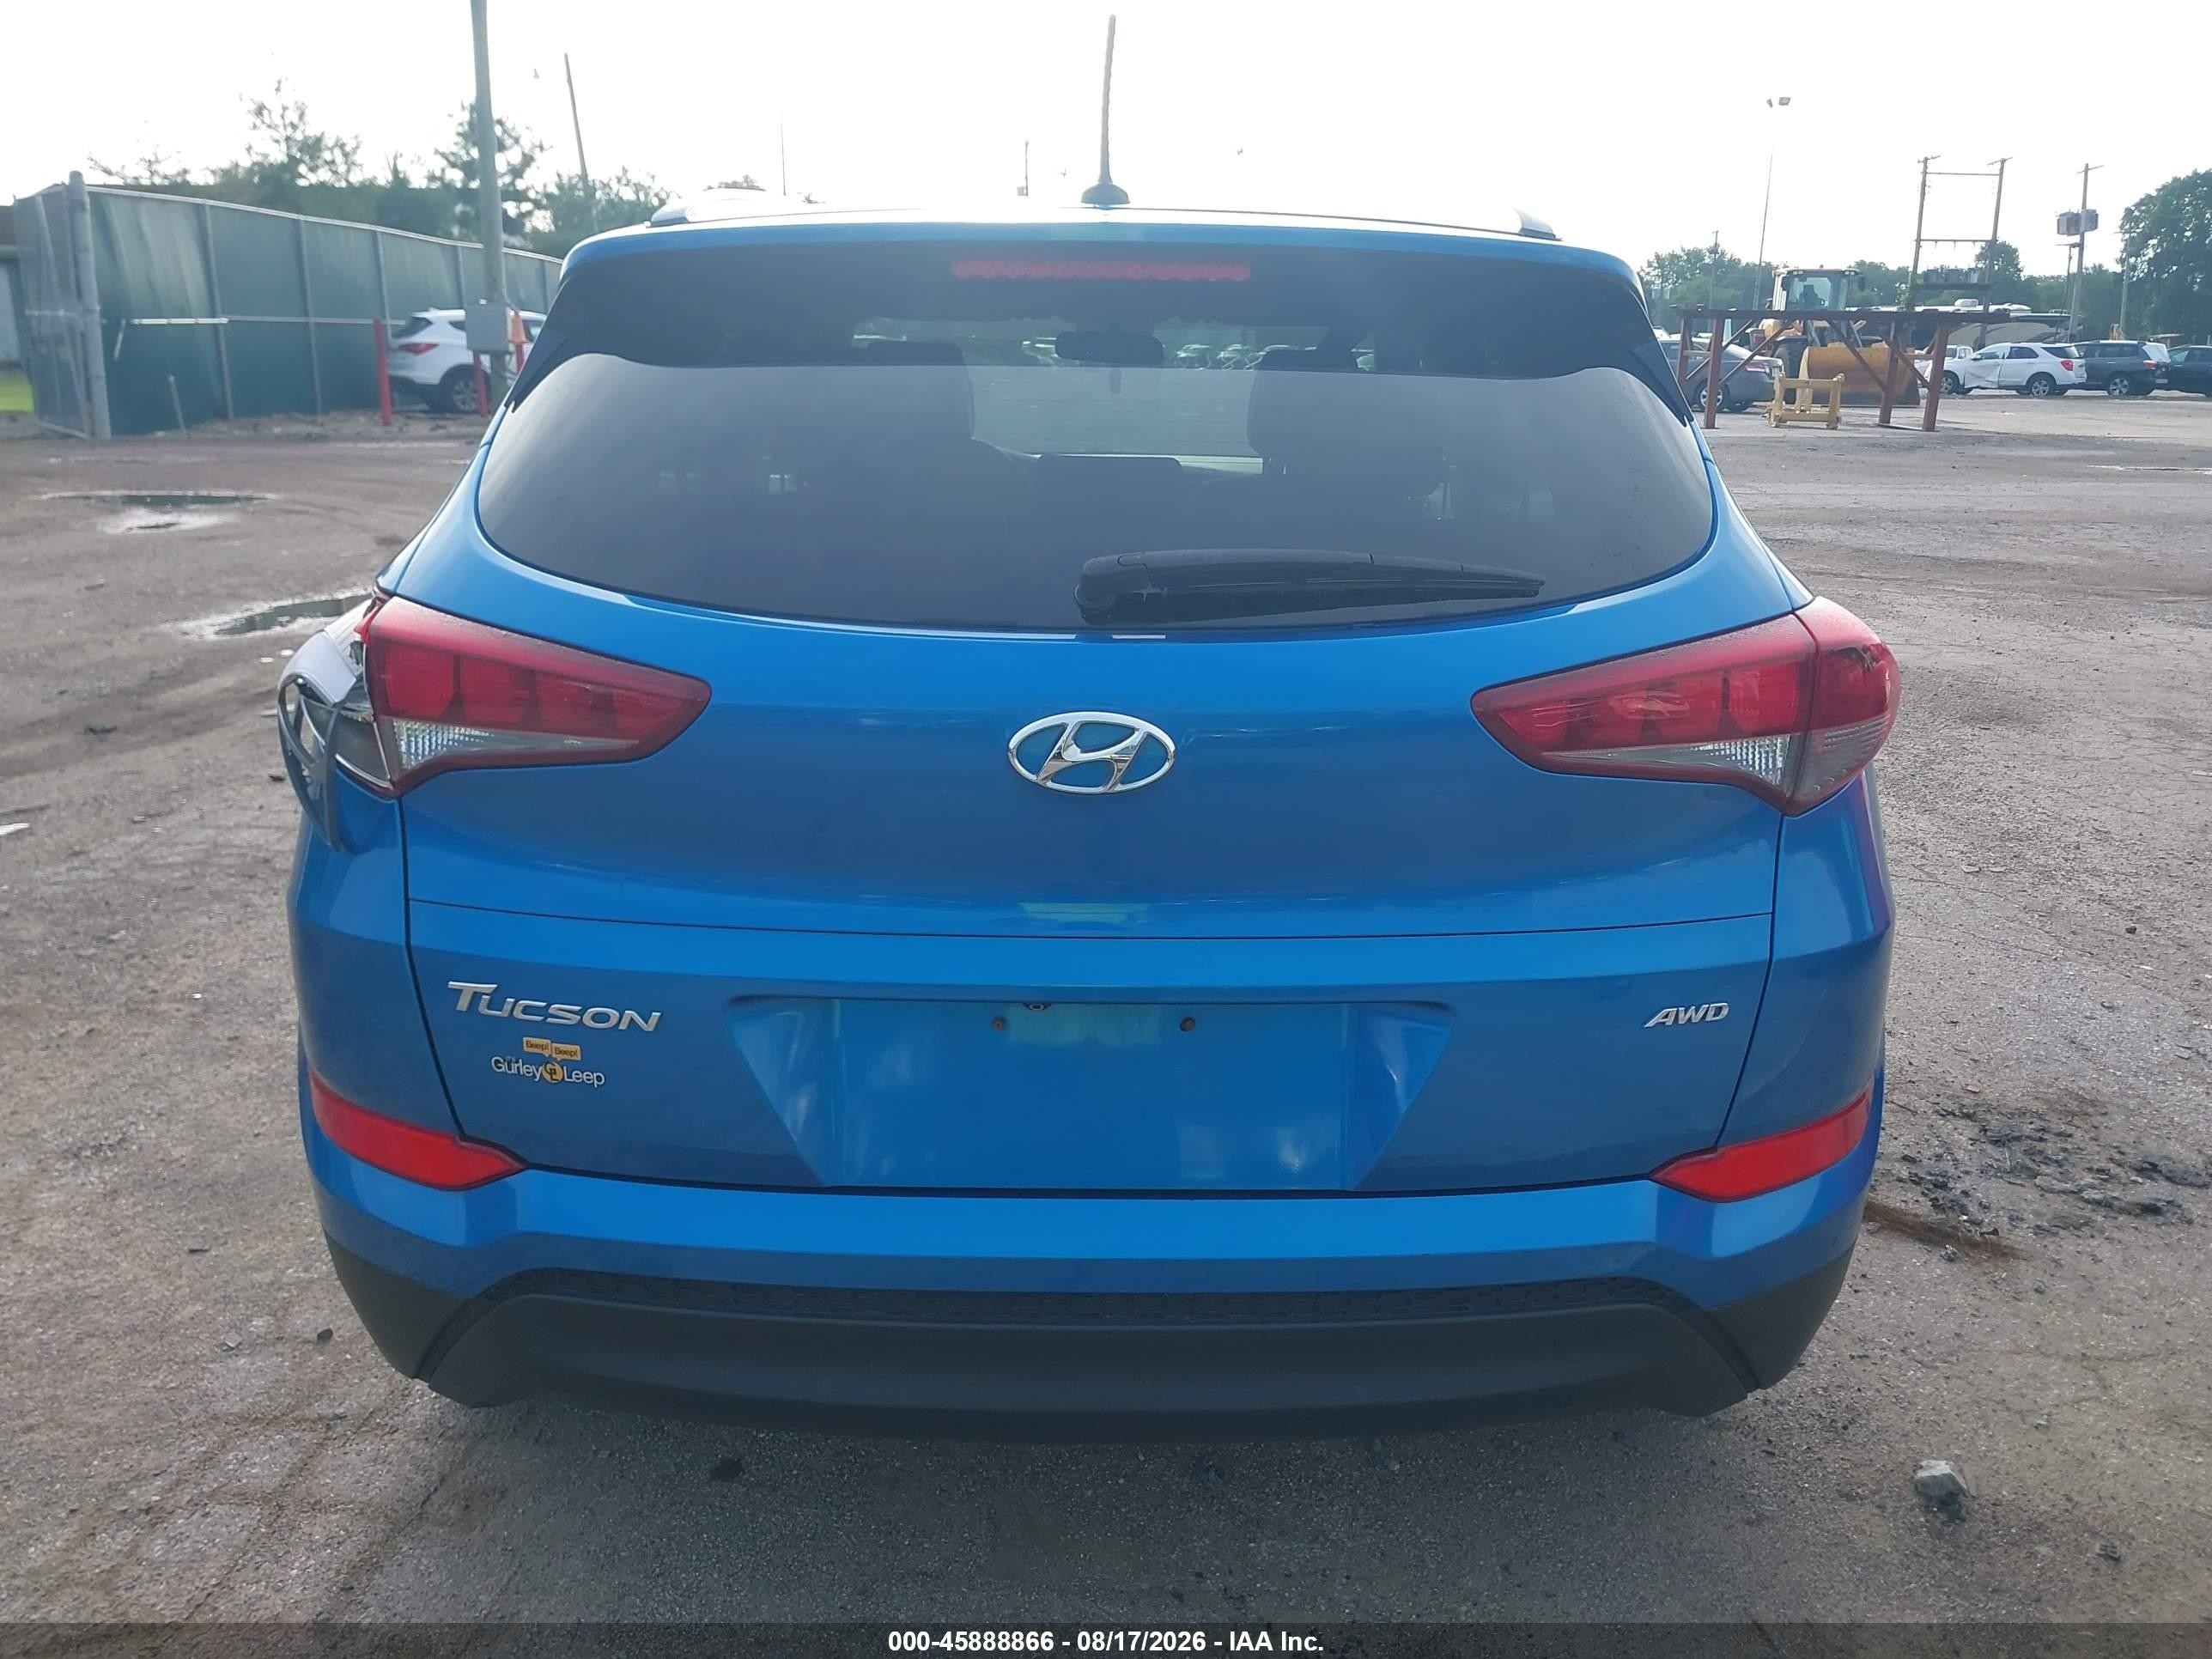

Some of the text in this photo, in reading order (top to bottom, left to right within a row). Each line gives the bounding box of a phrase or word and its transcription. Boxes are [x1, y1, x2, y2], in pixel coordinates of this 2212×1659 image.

[447, 981, 662, 1031] TUCSON
[1644, 1002, 1729, 1028] AWD
[526, 1040, 578, 1057] Beep! Beep!
[563, 1066, 605, 1088] Leep
